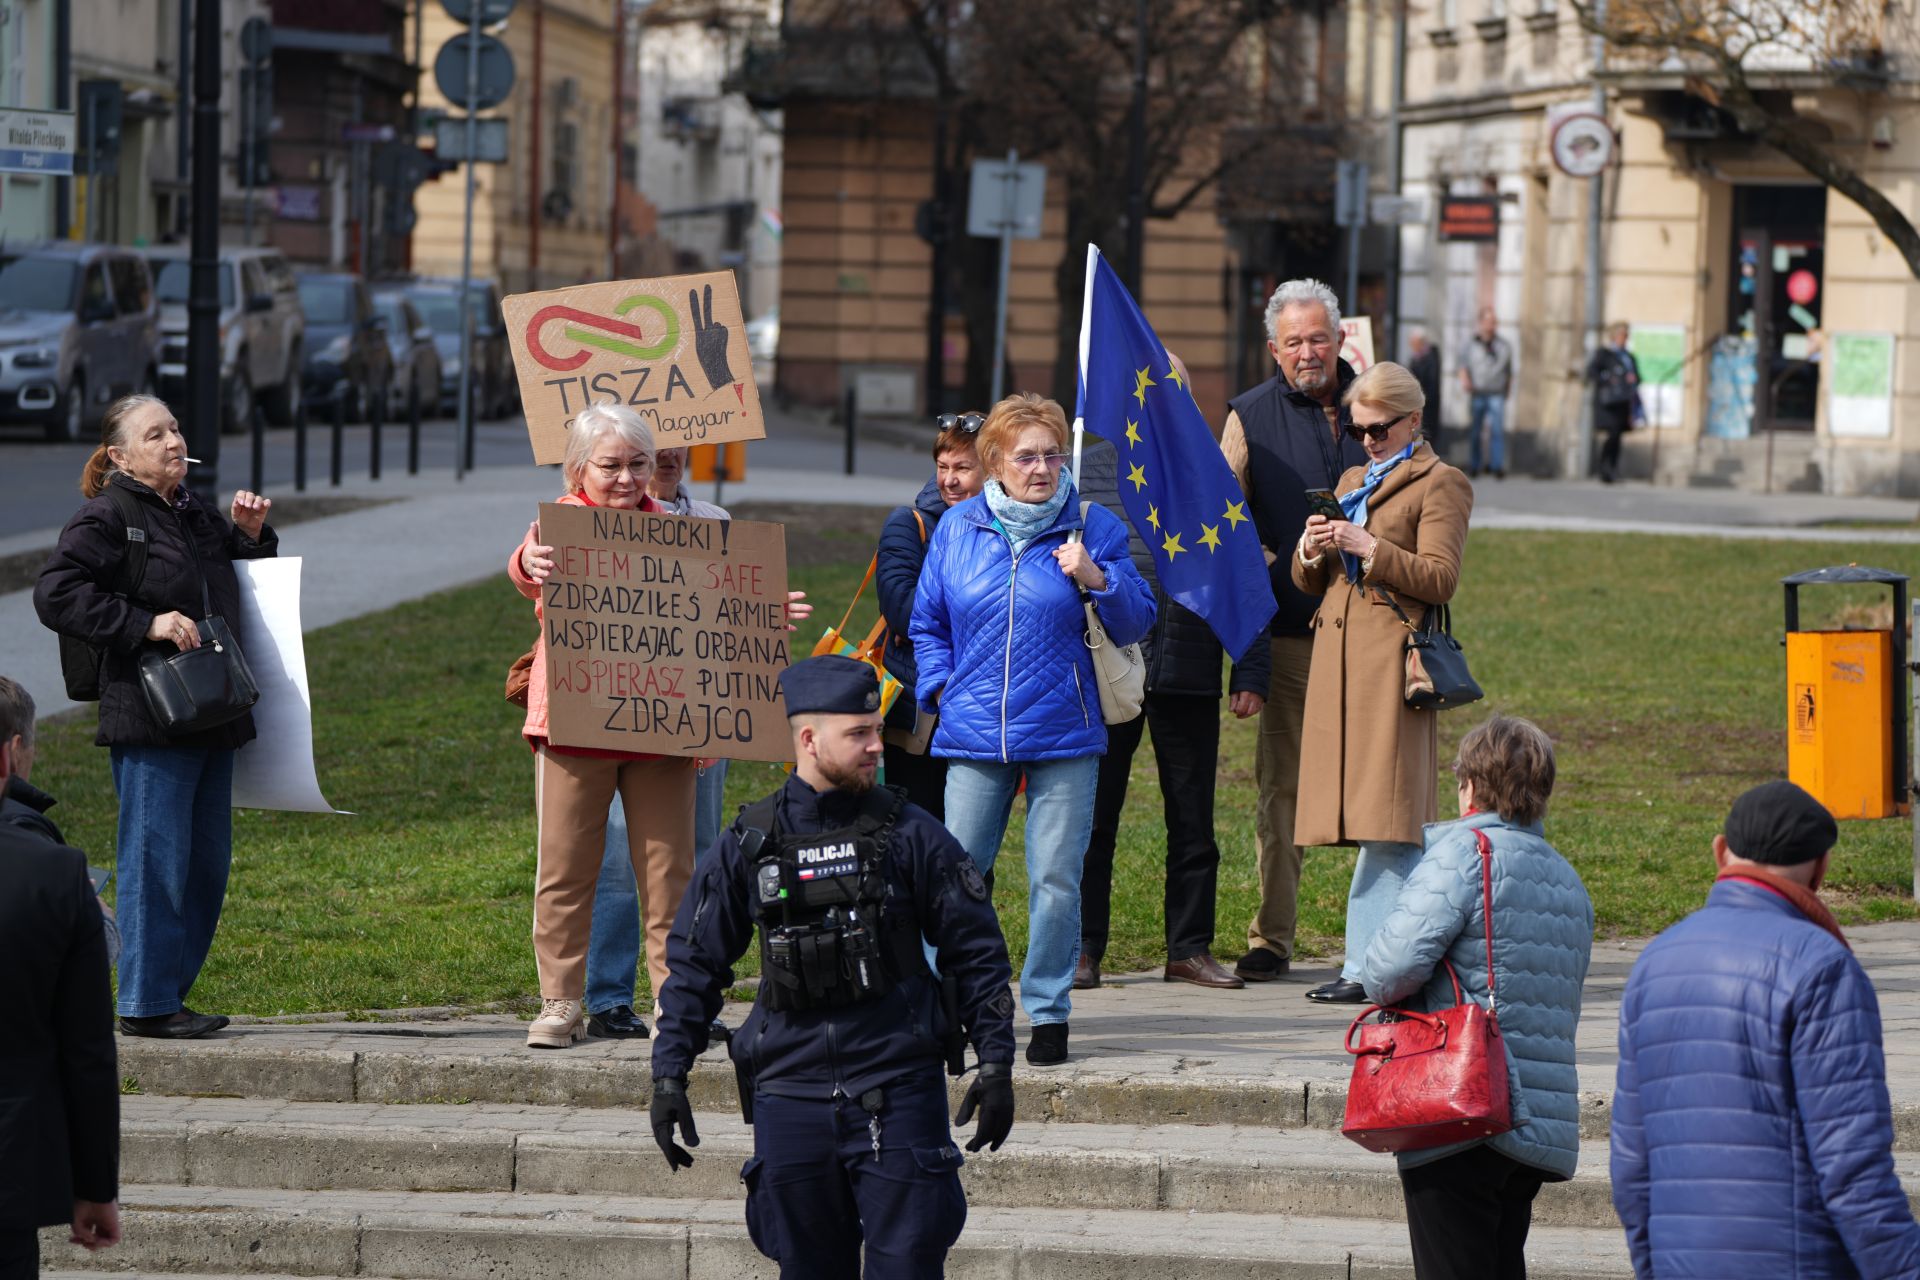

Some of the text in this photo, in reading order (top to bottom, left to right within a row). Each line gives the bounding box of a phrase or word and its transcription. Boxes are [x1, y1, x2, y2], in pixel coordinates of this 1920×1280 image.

[544, 364, 695, 414] TISZA
[641, 555, 685, 586] DLA
[702, 563, 763, 595] SAFE
[548, 582, 701, 622] ZDRADZIŁEŚ
[550, 619, 789, 666] WSPIERAJĄC ORBANA
[553, 660, 785, 703] WSPIERASZ PUTINA
[604, 696, 753, 750] ZDRAJCO
[798, 843, 855, 864] POLICJA
